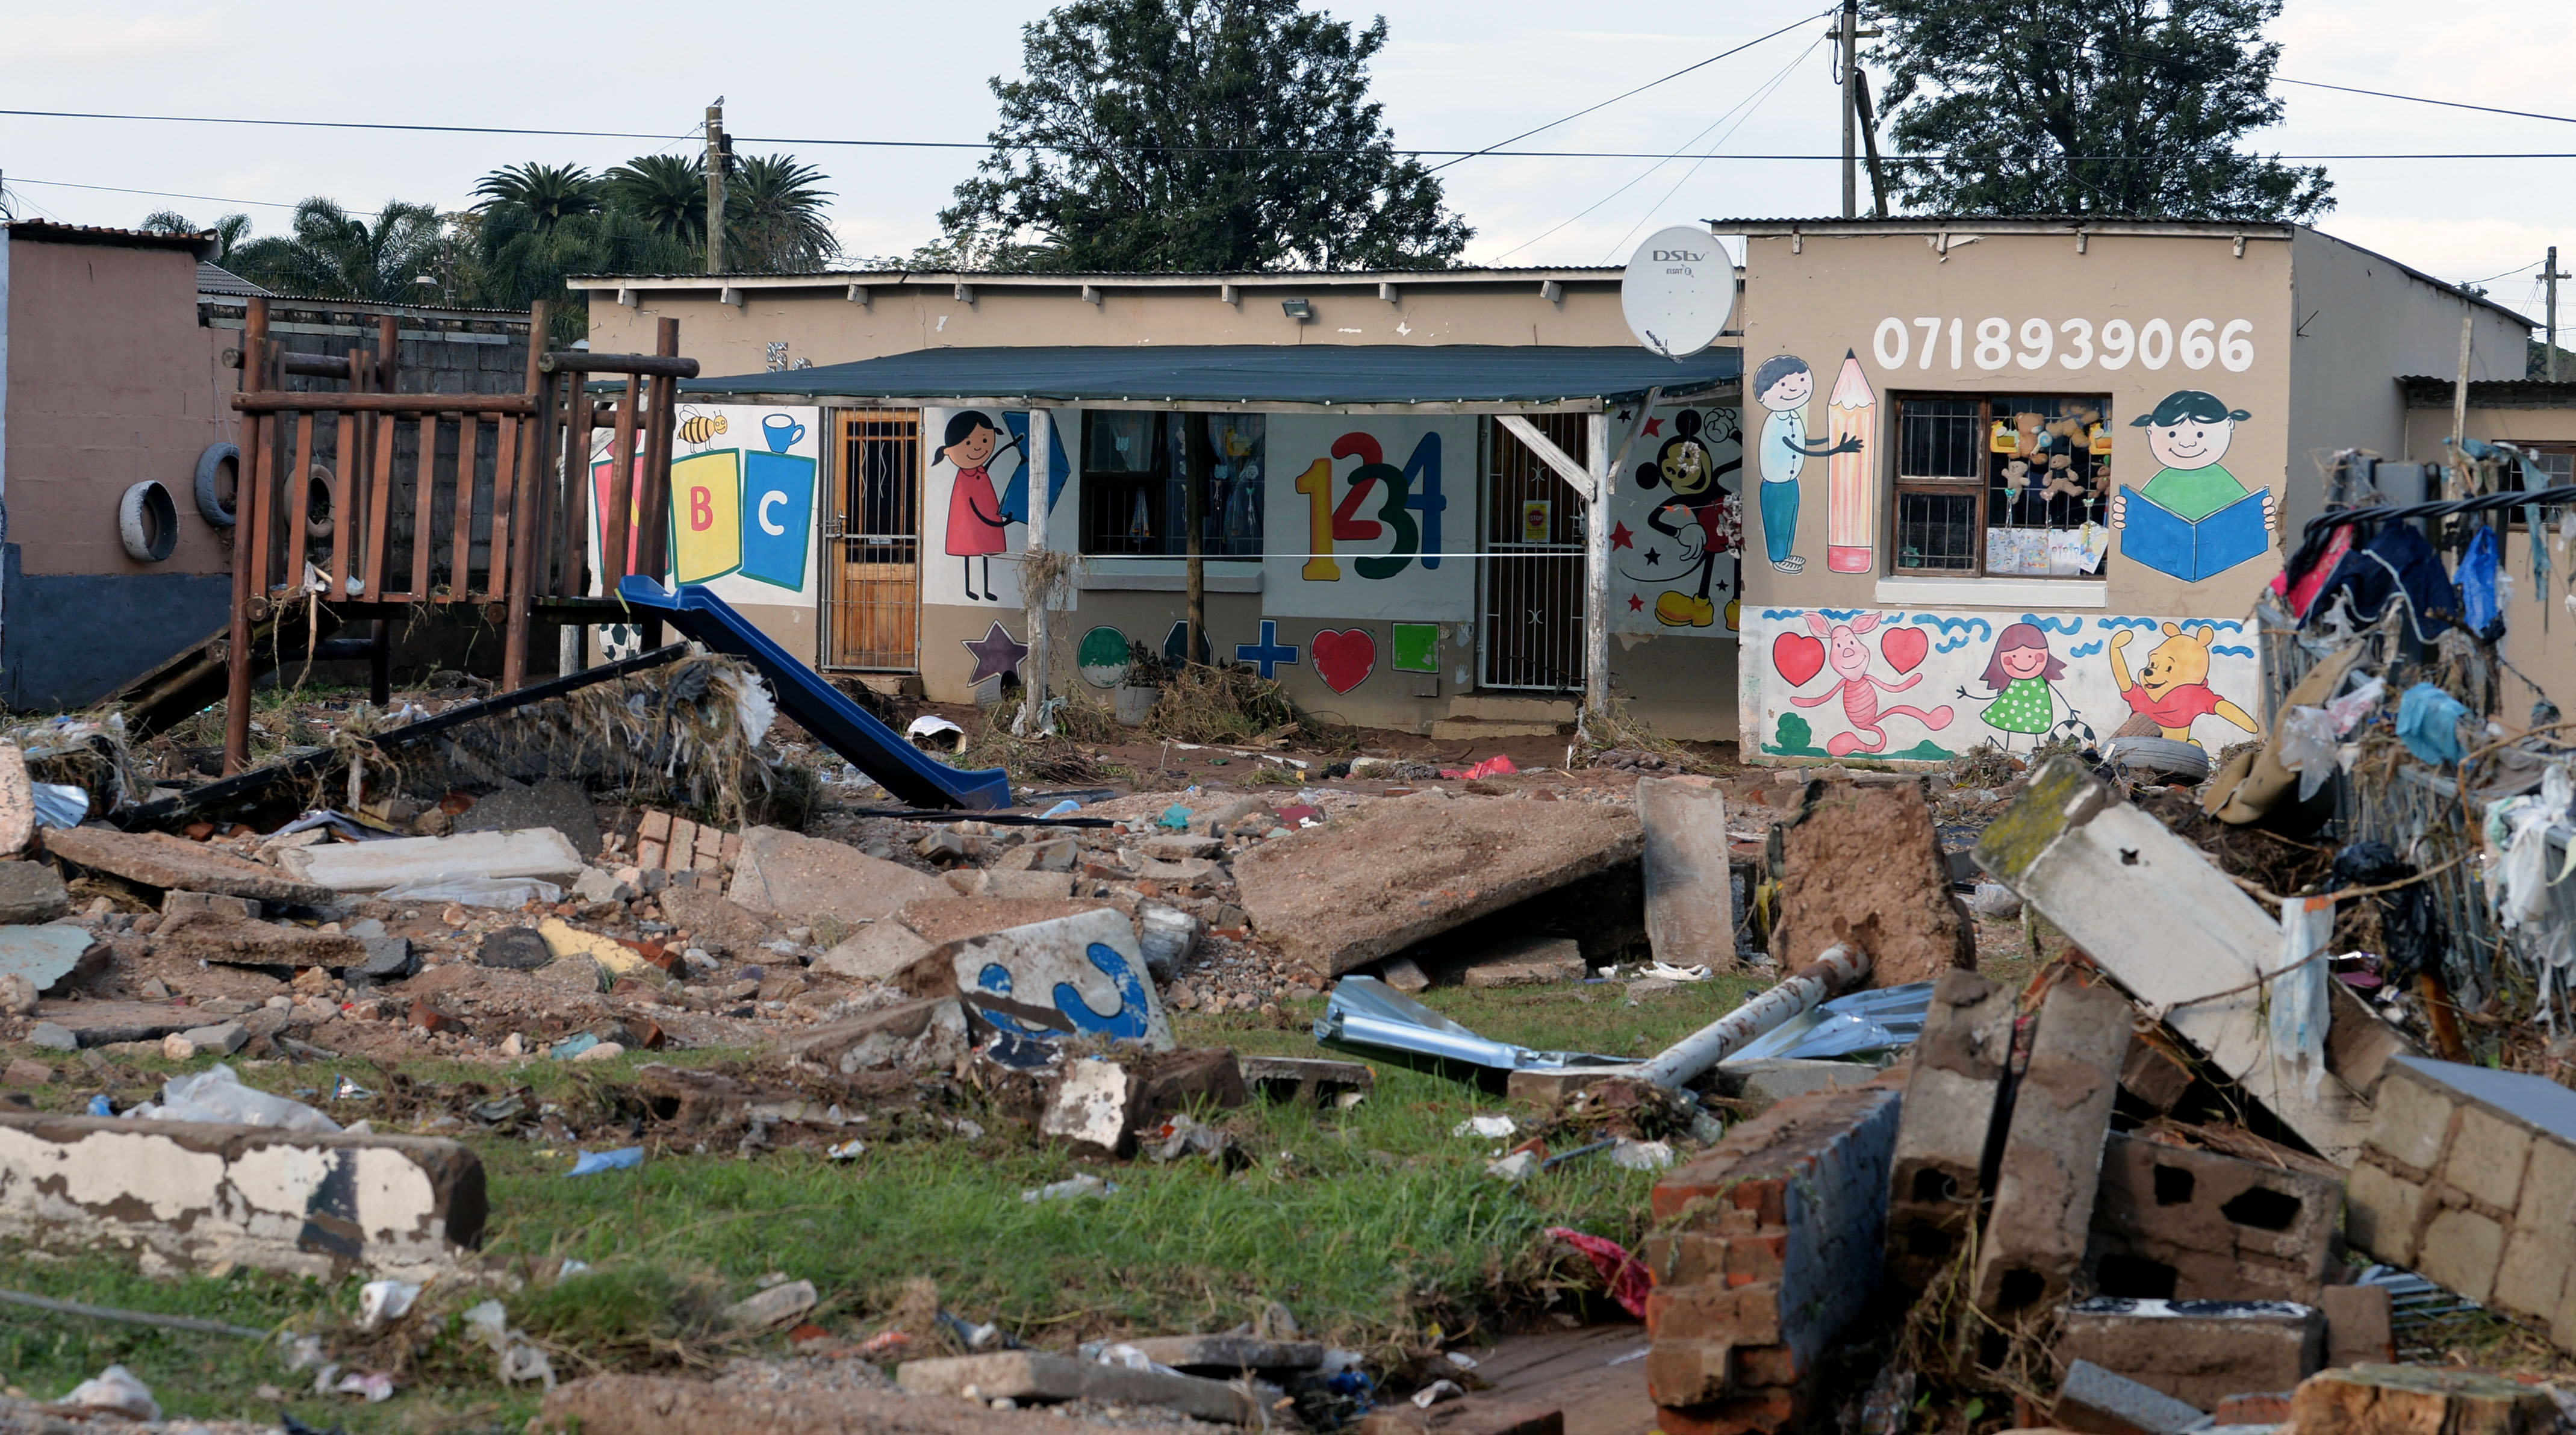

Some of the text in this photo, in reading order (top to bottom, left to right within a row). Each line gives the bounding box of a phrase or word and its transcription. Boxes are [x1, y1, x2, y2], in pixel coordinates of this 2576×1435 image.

[766, 341, 813, 373] 5
[1873, 316, 2254, 373] 0718939066
[690, 485, 714, 532] B
[758, 490, 788, 536] C
